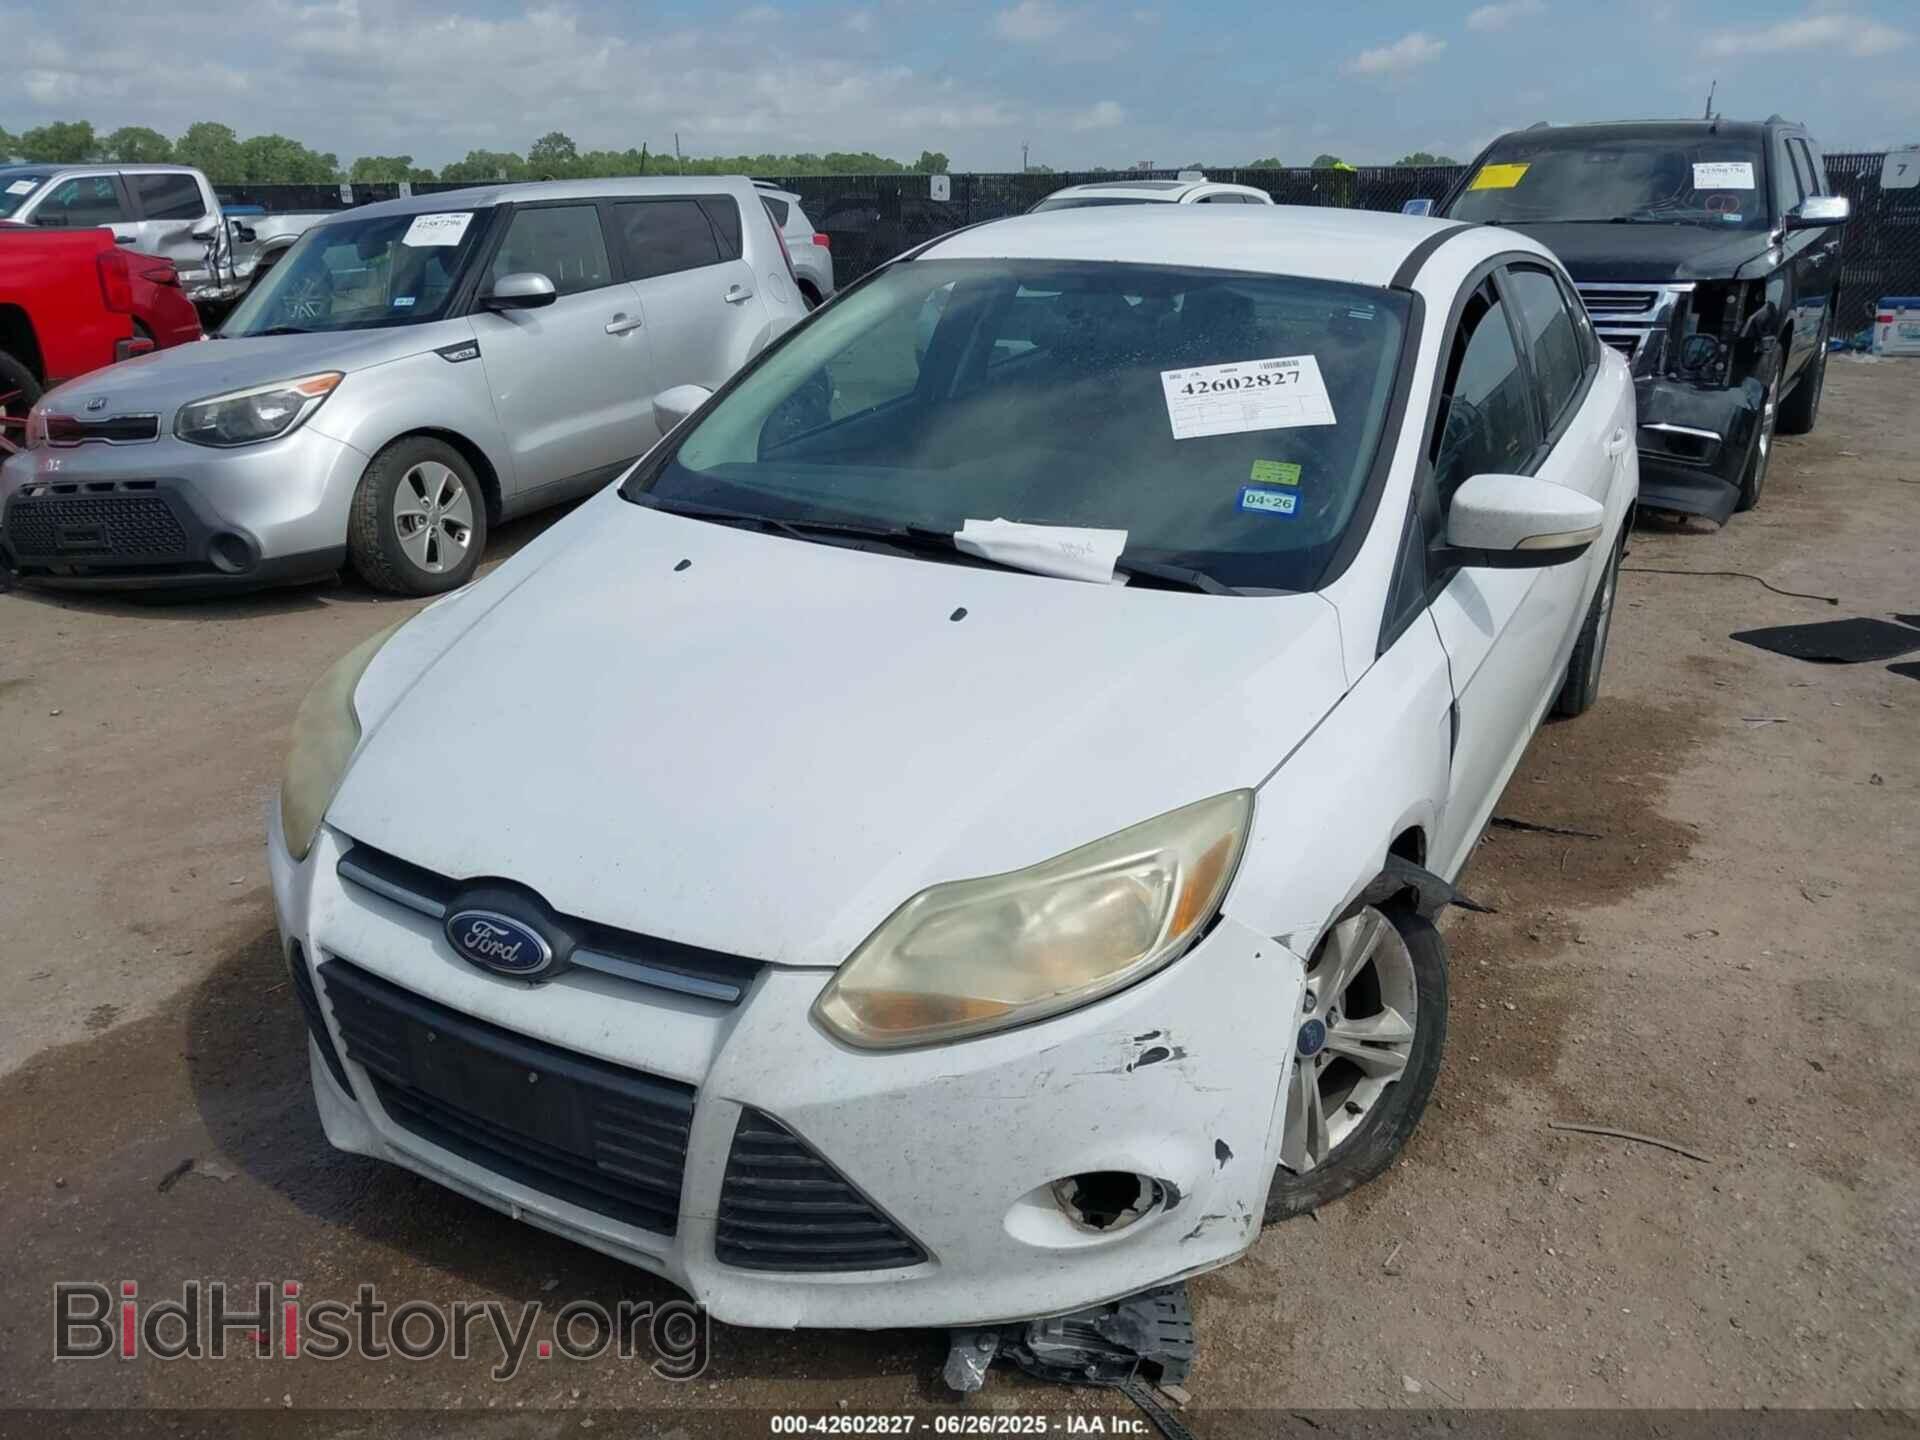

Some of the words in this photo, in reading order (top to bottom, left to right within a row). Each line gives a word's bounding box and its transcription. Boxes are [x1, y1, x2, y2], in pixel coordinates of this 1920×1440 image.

[1896, 163, 1908, 177] 7
[1181, 370, 1300, 396] 42602827
[464, 920, 522, 962] Ford
